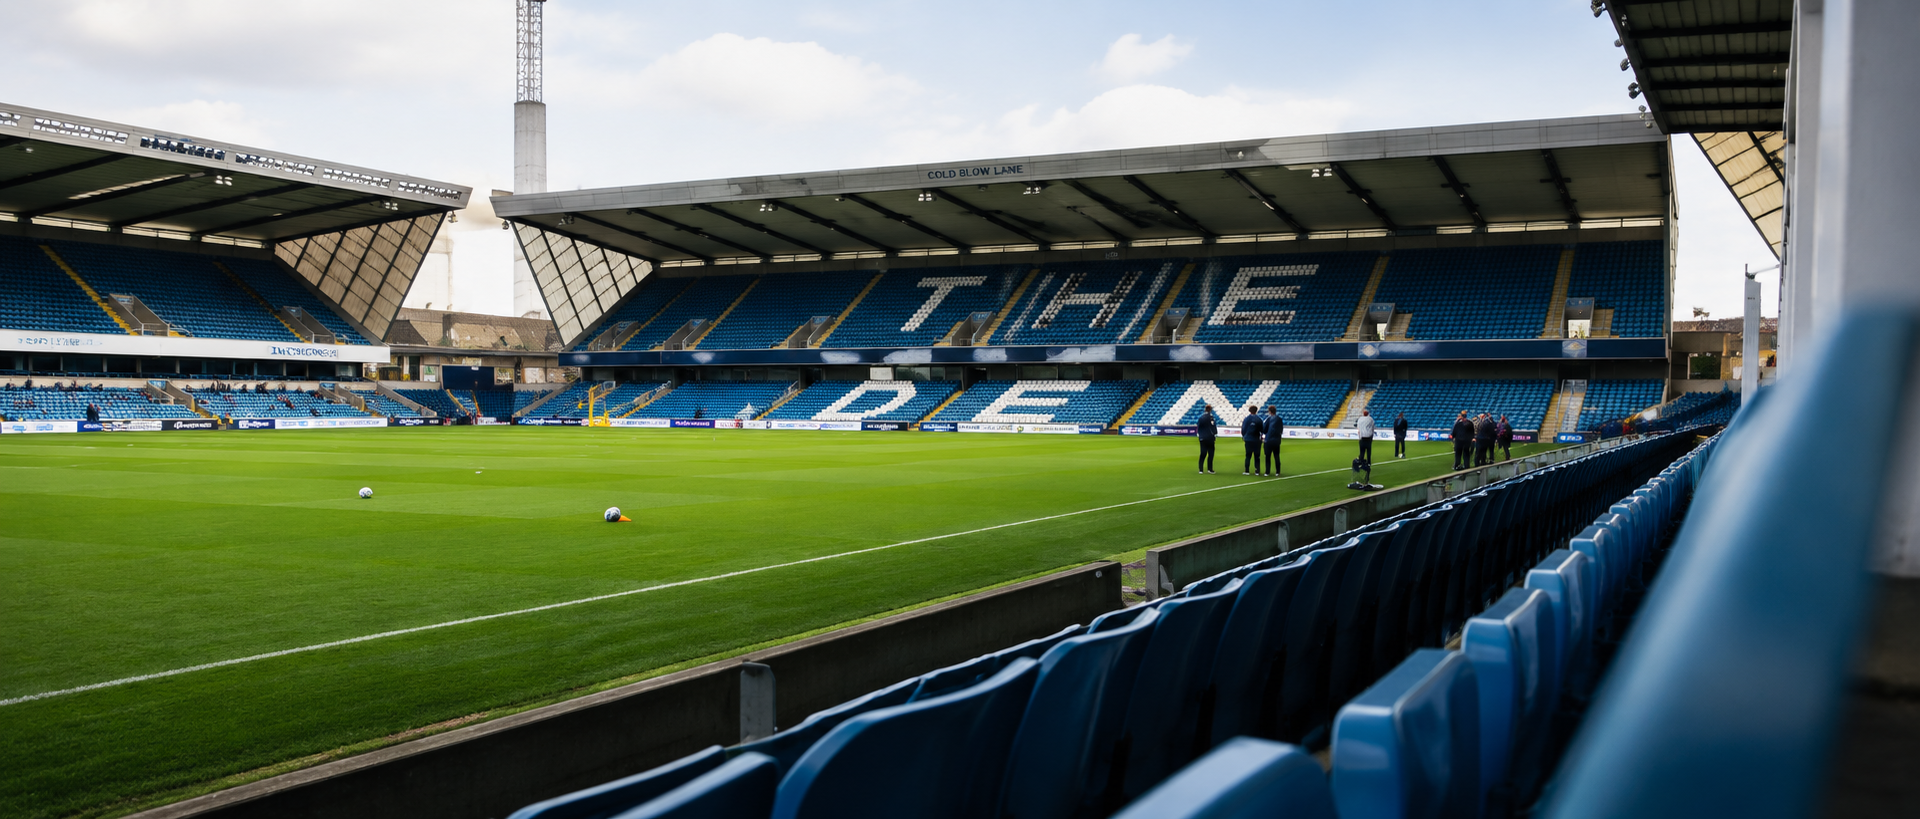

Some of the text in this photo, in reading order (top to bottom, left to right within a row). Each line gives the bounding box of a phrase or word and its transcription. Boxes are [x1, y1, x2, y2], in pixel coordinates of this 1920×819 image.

[927, 164, 1024, 180] COLD BLOW LANE
[901, 264, 1320, 332] THE
[811, 380, 1281, 427] DEN
